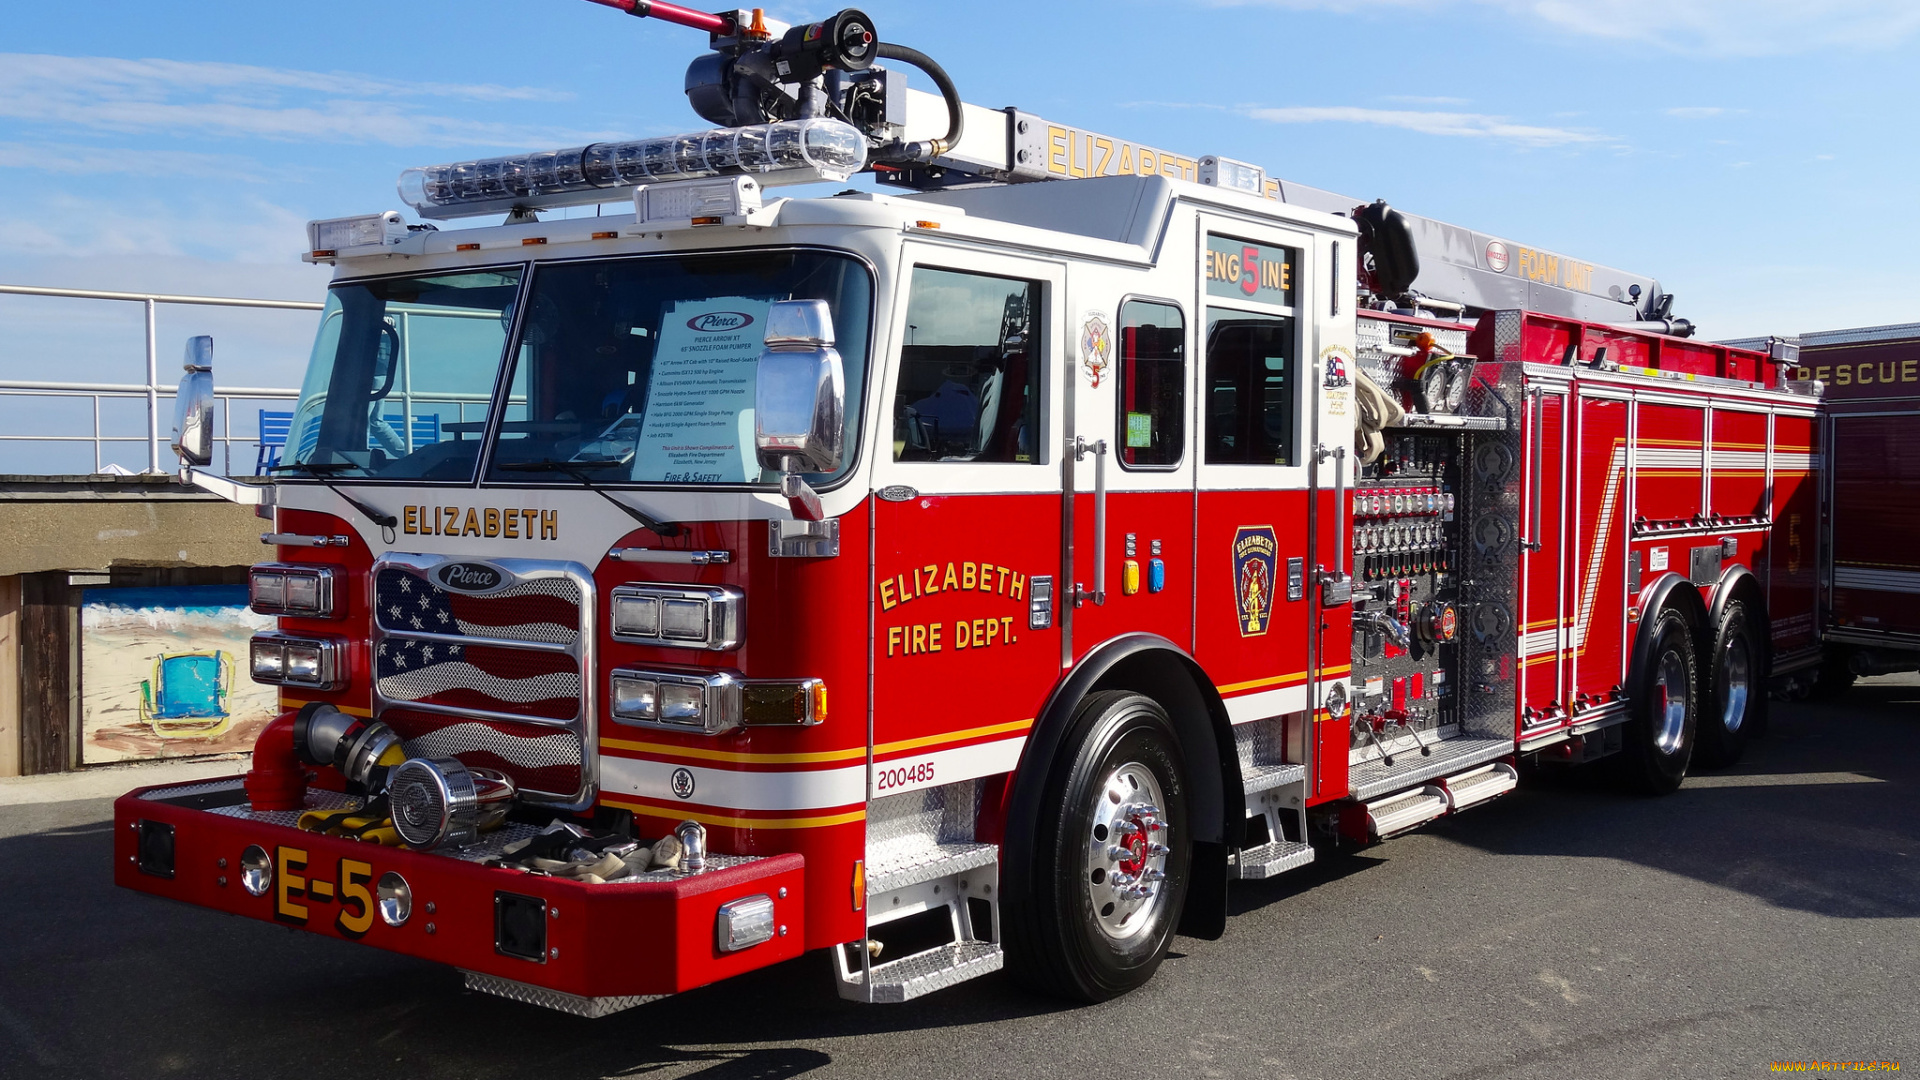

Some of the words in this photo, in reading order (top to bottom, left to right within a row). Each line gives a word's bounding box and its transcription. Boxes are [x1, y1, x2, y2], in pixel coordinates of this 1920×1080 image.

[1048, 125, 1199, 184] ELIZABET
[1519, 247, 1558, 286] FOAM
[1564, 258, 1594, 294] UNIT
[701, 316, 738, 328] Pierce
[664, 472, 682, 482] FIRE
[683, 472, 690, 482] &
[692, 472, 722, 482] SAFETY
[404, 506, 558, 540] ELIZABETH
[1236, 535, 1274, 553] ELIZABETH
[1788, 514, 1800, 575] 5
[447, 564, 494, 585] Pierce
[880, 562, 1026, 611] ELIZABETH
[888, 622, 942, 656] FIRE
[956, 616, 1018, 649] DEPT.
[878, 762, 934, 790] 200485
[275, 845, 374, 936] E-5
